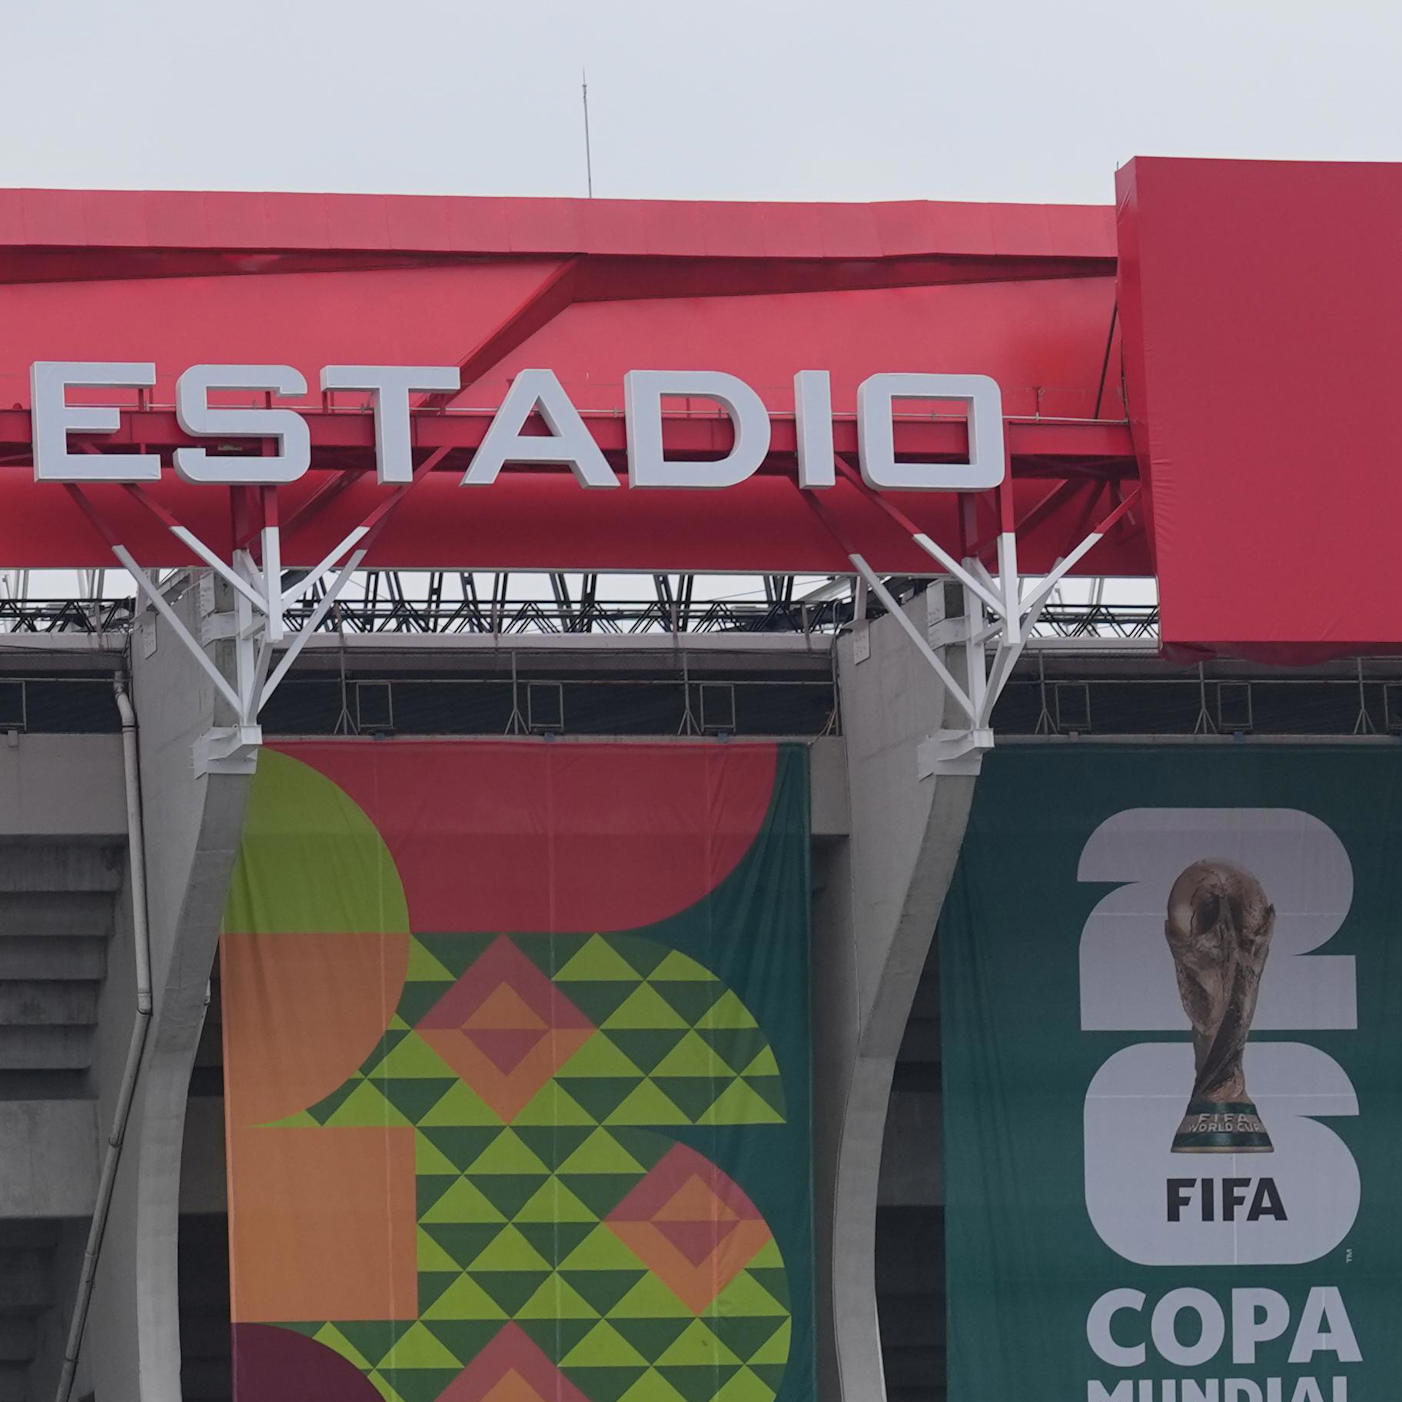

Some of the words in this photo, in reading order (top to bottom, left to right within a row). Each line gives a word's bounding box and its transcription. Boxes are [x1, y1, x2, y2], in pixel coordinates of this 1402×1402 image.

[31, 361, 1006, 493] ESTADIO
[1188, 1122, 1233, 1132] WORLD
[1237, 1122, 1261, 1132] CUP
[1199, 1113, 1250, 1123] FIFA
[1166, 1177, 1288, 1222] FIFA
[1086, 1286, 1364, 1367] COPA
